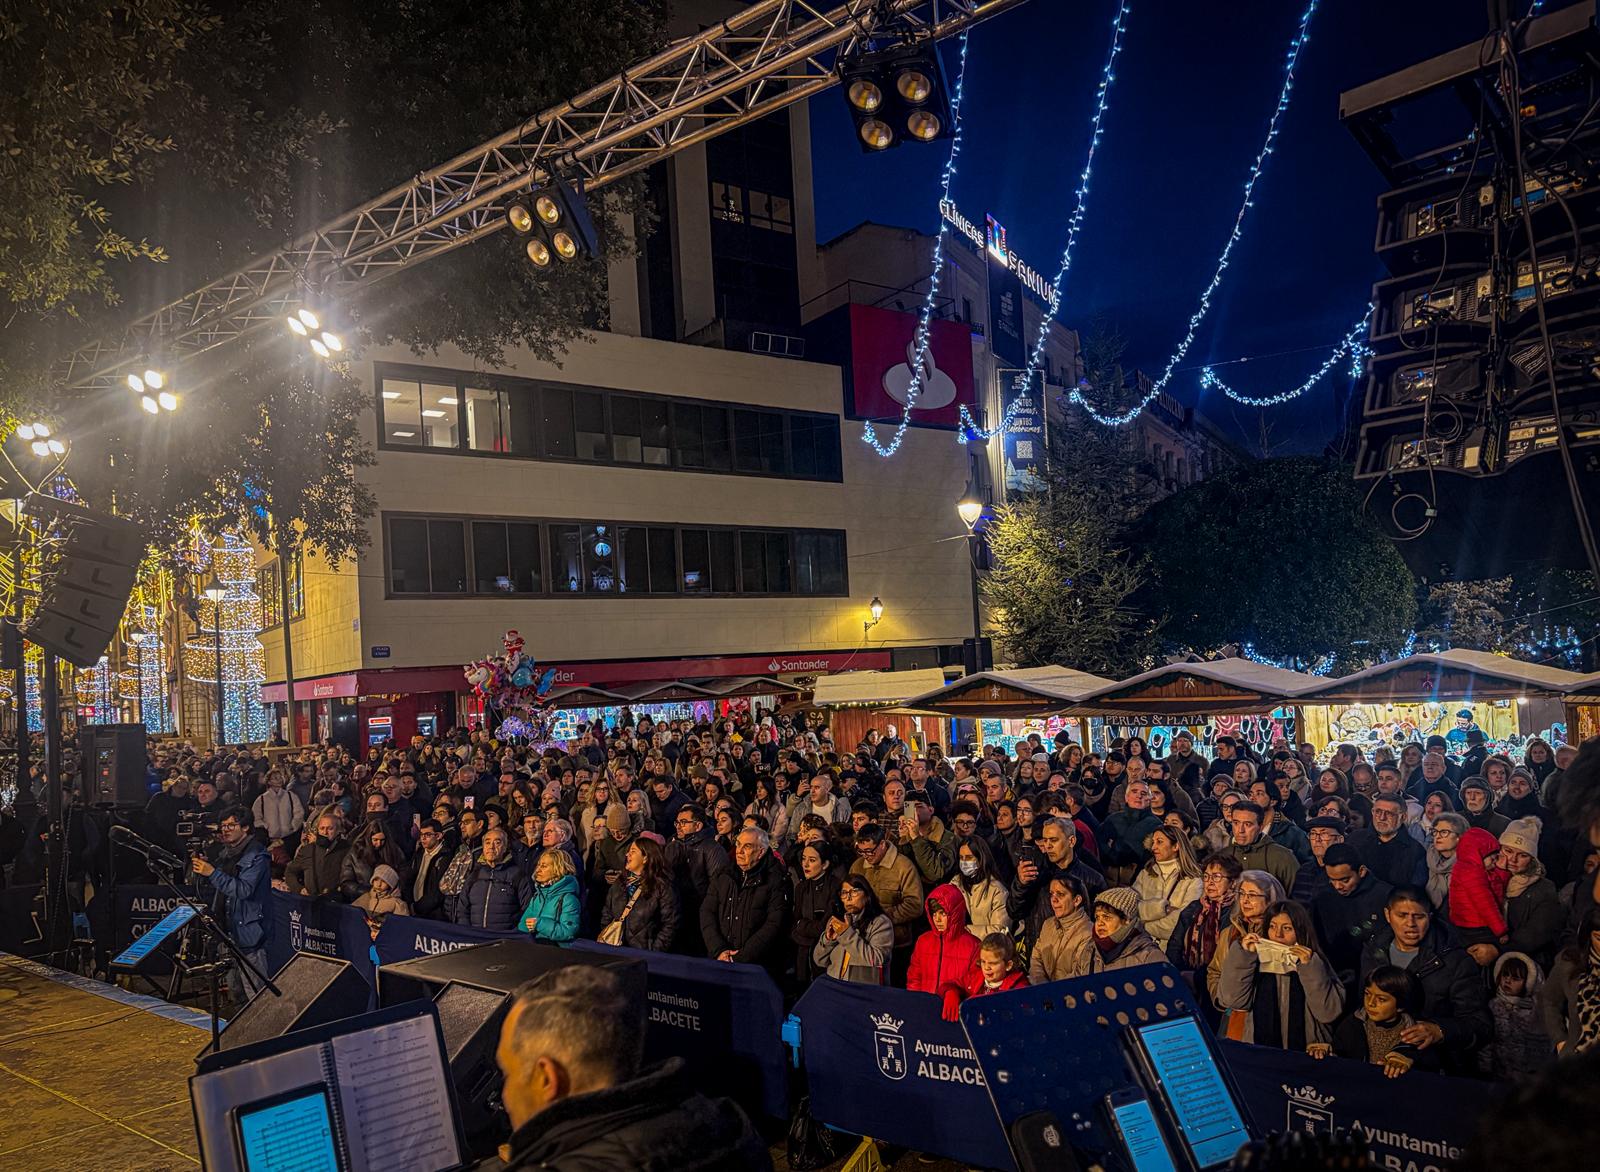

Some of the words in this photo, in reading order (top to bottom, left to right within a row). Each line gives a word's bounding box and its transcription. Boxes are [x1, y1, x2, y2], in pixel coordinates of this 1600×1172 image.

[781, 659, 829, 671] Santander
[554, 670, 576, 682] der
[1105, 715, 1148, 726] PERLAS
[1152, 714, 1163, 725] &
[1166, 714, 1204, 726] PLATA
[304, 938, 337, 955] ALBACETE
[647, 991, 699, 1010] untamiento
[648, 1007, 701, 1031] BACETE
[914, 1039, 976, 1061] Ayuntam
[917, 1060, 986, 1087] ALBACE
[1352, 1119, 1464, 1161] Ayuntamie
